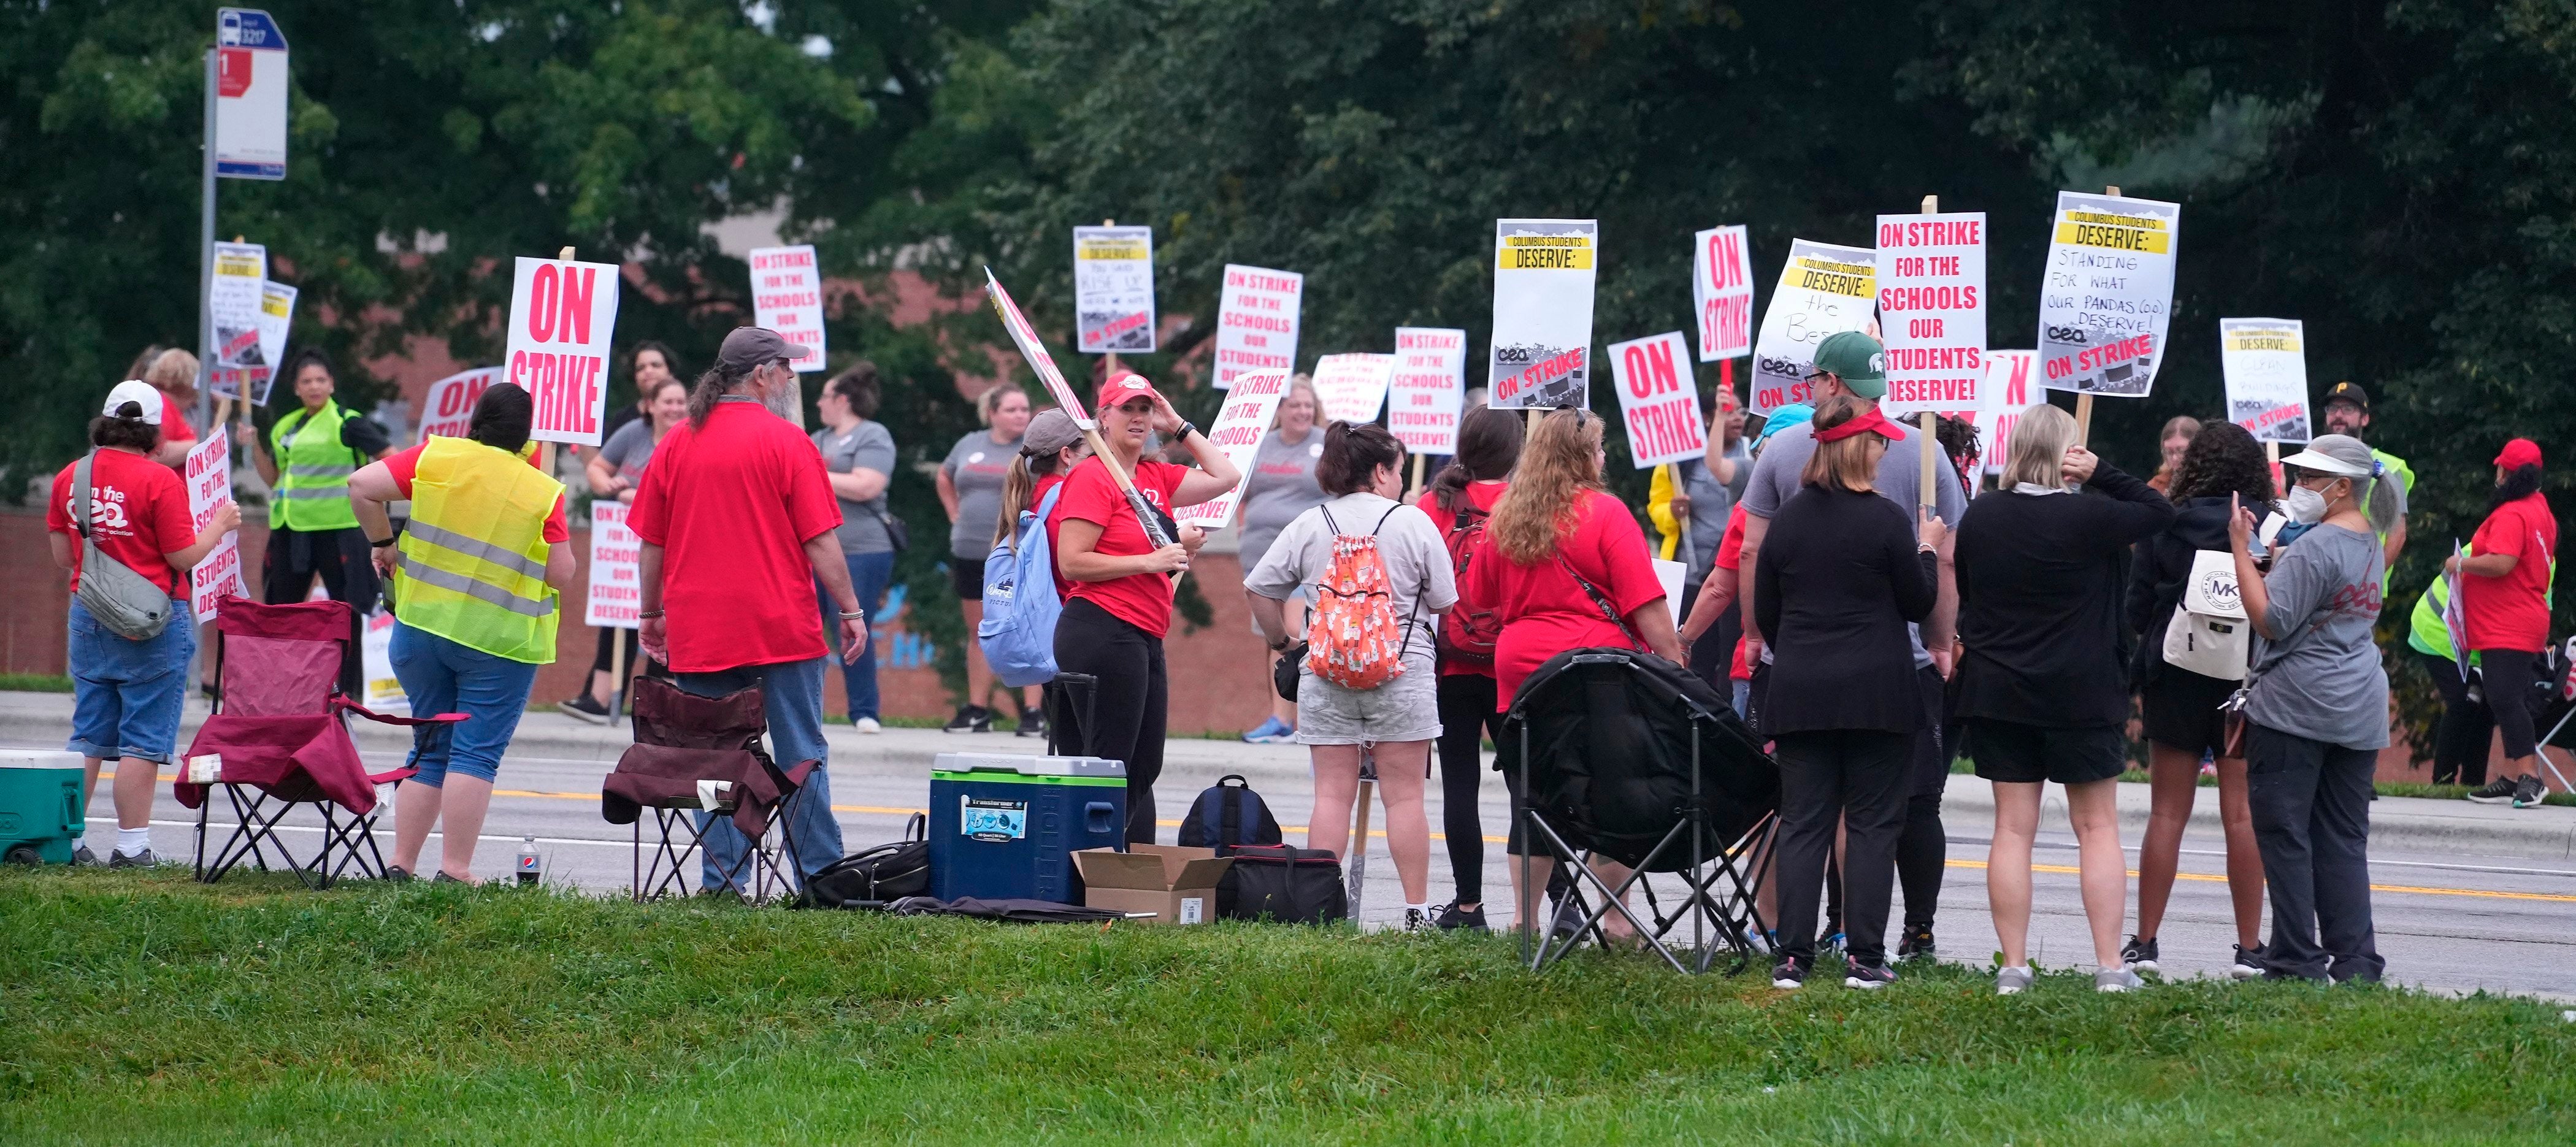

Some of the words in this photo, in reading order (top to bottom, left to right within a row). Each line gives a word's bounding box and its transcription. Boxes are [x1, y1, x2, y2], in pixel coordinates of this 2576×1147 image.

[2074, 212, 2114, 225] COLUMBUS
[2115, 216, 2156, 229] STUDENTS
[1513, 237, 1545, 247] COLUMBUS
[1547, 237, 1582, 247] STUDENTS
[1880, 223, 1904, 248] ON
[1907, 221, 1980, 247] STRIKE
[2076, 224, 2150, 251] DESERVE:
[754, 255, 768, 269] ON
[770, 252, 812, 269] STRIKE
[1517, 248, 1576, 269] DESERVE:
[1709, 232, 1743, 290] ON
[1804, 258, 1840, 272] COLUMBUS
[1841, 263, 1871, 276] STUDENTS
[1896, 257, 1924, 277] FOR
[1929, 256, 1960, 276] THE
[2058, 249, 2138, 270] STANDING
[764, 275, 781, 288] FOR
[785, 274, 803, 286] THE
[1228, 272, 1246, 287] ON
[1249, 274, 1298, 294] STRIKE
[1802, 270, 1866, 297] DESERVE:
[2050, 271, 2077, 288] FOR
[2090, 276, 2128, 290] WHAT
[529, 263, 596, 345] ON
[757, 291, 816, 309] SCHOOLS
[1238, 294, 1258, 307] FOR
[1261, 297, 1281, 310] THE
[1805, 294, 1839, 317] the
[1880, 286, 1977, 312] SCHOOLS
[2047, 294, 2074, 309] OUR
[2084, 295, 2135, 315] PANDAS
[1224, 312, 1290, 334] SCHOOLS
[1704, 294, 1750, 353] STRIKE
[1909, 319, 1943, 339] OUR
[2079, 312, 2153, 334] DESERVE!
[1244, 335, 1267, 347] OUR
[1399, 334, 1414, 349] ON
[1416, 334, 1460, 350] STRIKE
[2240, 338, 2289, 351] DESERVE:
[1219, 349, 1290, 369] STUDENTS
[1408, 356, 1424, 367] FOR
[1427, 356, 1444, 368] THE
[1885, 347, 1980, 371] STUDENTS
[2047, 355, 2073, 380] ON
[2078, 334, 2153, 372] STRIKE
[1497, 374, 1519, 401] ON
[1524, 347, 1584, 388] STRIKE
[1624, 339, 1680, 399] ON
[1227, 380, 1241, 401] ON
[1240, 375, 1285, 397] STRIKE
[1394, 374, 1454, 389] SCHOOLS
[1888, 378, 1976, 402] DESERVE!
[2336, 382, 2347, 394] P
[1411, 394, 1432, 406] OUR
[1758, 386, 1785, 409] ON
[1223, 404, 1240, 423] FOR
[1239, 402, 1262, 419] THE
[1391, 412, 1454, 426] STUDENTS
[2259, 402, 2304, 428] STRIKE
[1209, 426, 1262, 448] SCHOOLS
[1628, 397, 1703, 461] STRIKE
[188, 452, 204, 479] ON
[204, 432, 226, 469] STRIKE
[103, 485, 125, 503] the
[201, 476, 213, 501] FO
[212, 468, 225, 491] THE
[596, 506, 613, 521] ON
[607, 528, 623, 542] FOR
[596, 547, 639, 564] SCHOO
[613, 568, 634, 580] OUR
[592, 584, 638, 600] STUDEN
[2212, 580, 2239, 597] MK
[594, 604, 639, 620] DESERV
